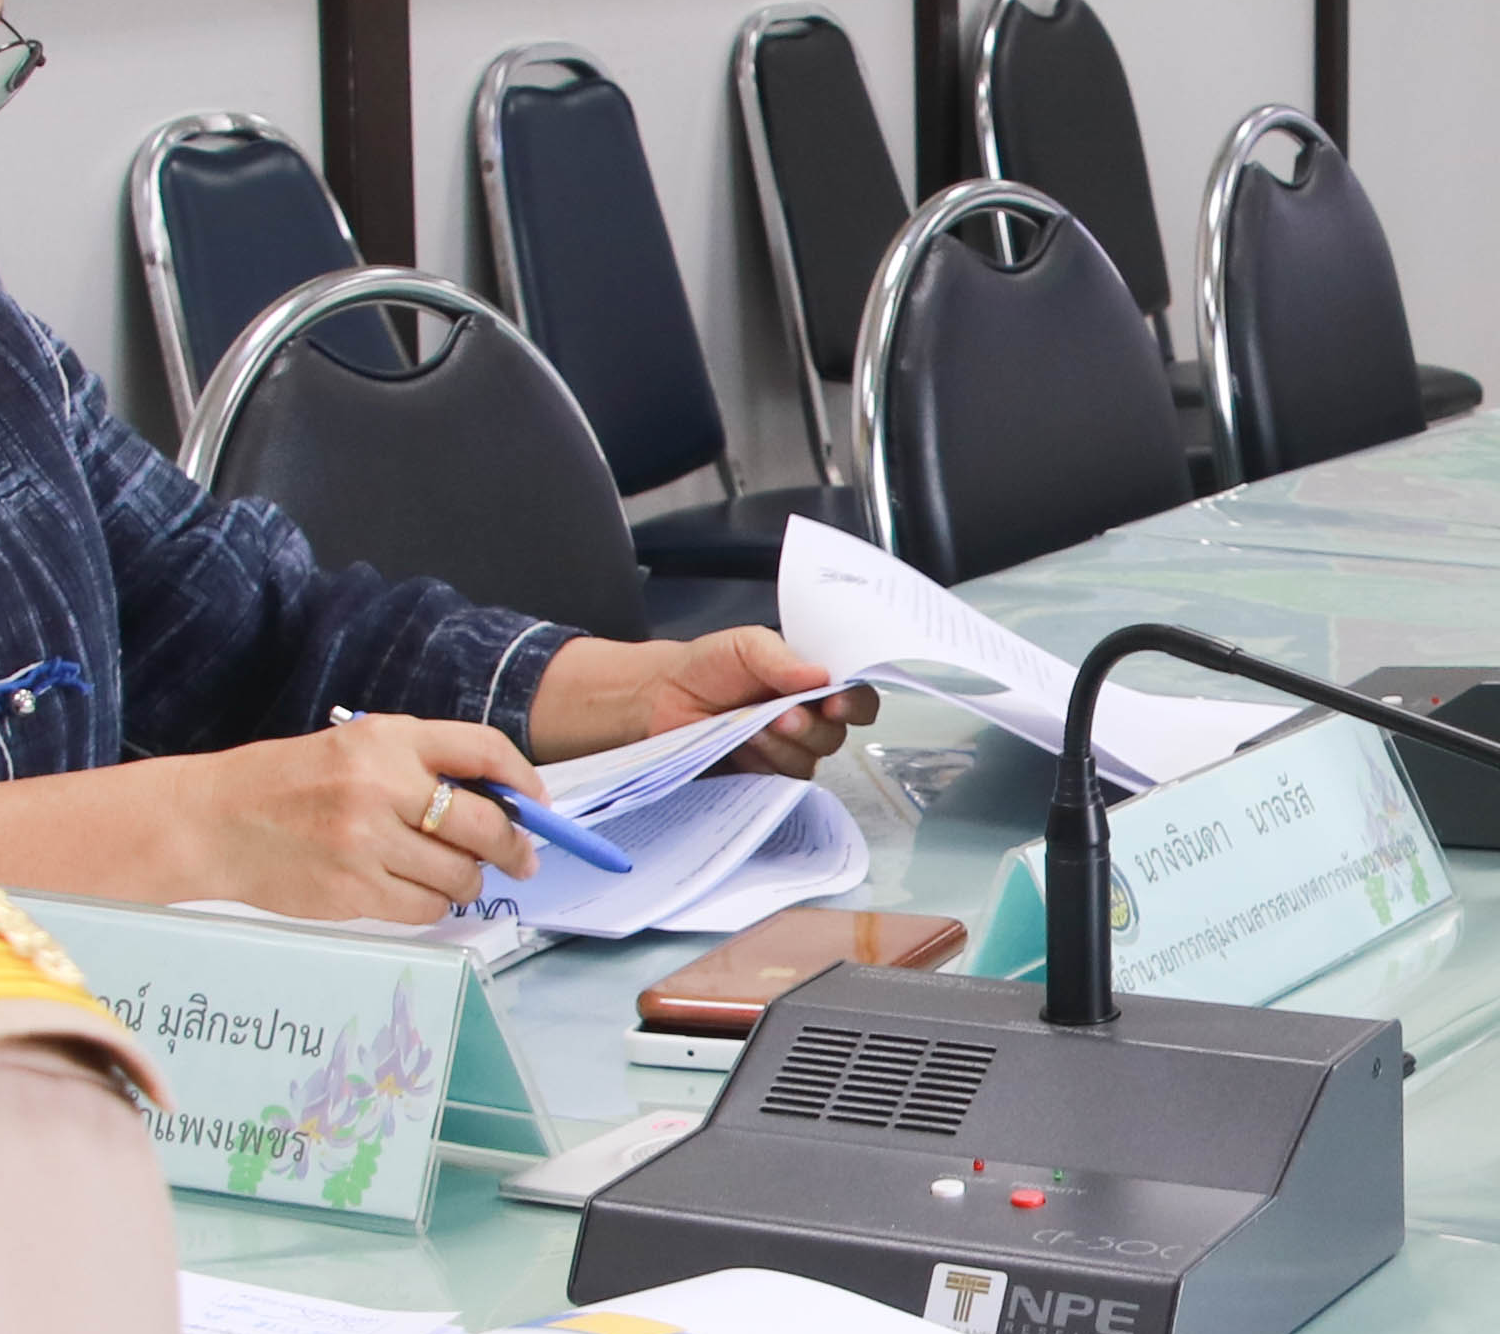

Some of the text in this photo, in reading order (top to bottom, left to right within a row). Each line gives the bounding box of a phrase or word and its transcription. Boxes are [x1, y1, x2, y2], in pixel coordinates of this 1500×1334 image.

[1134, 772, 1316, 886] นางจินดา นาจรัส
[158, 992, 325, 1059] มุสิกะปาน
